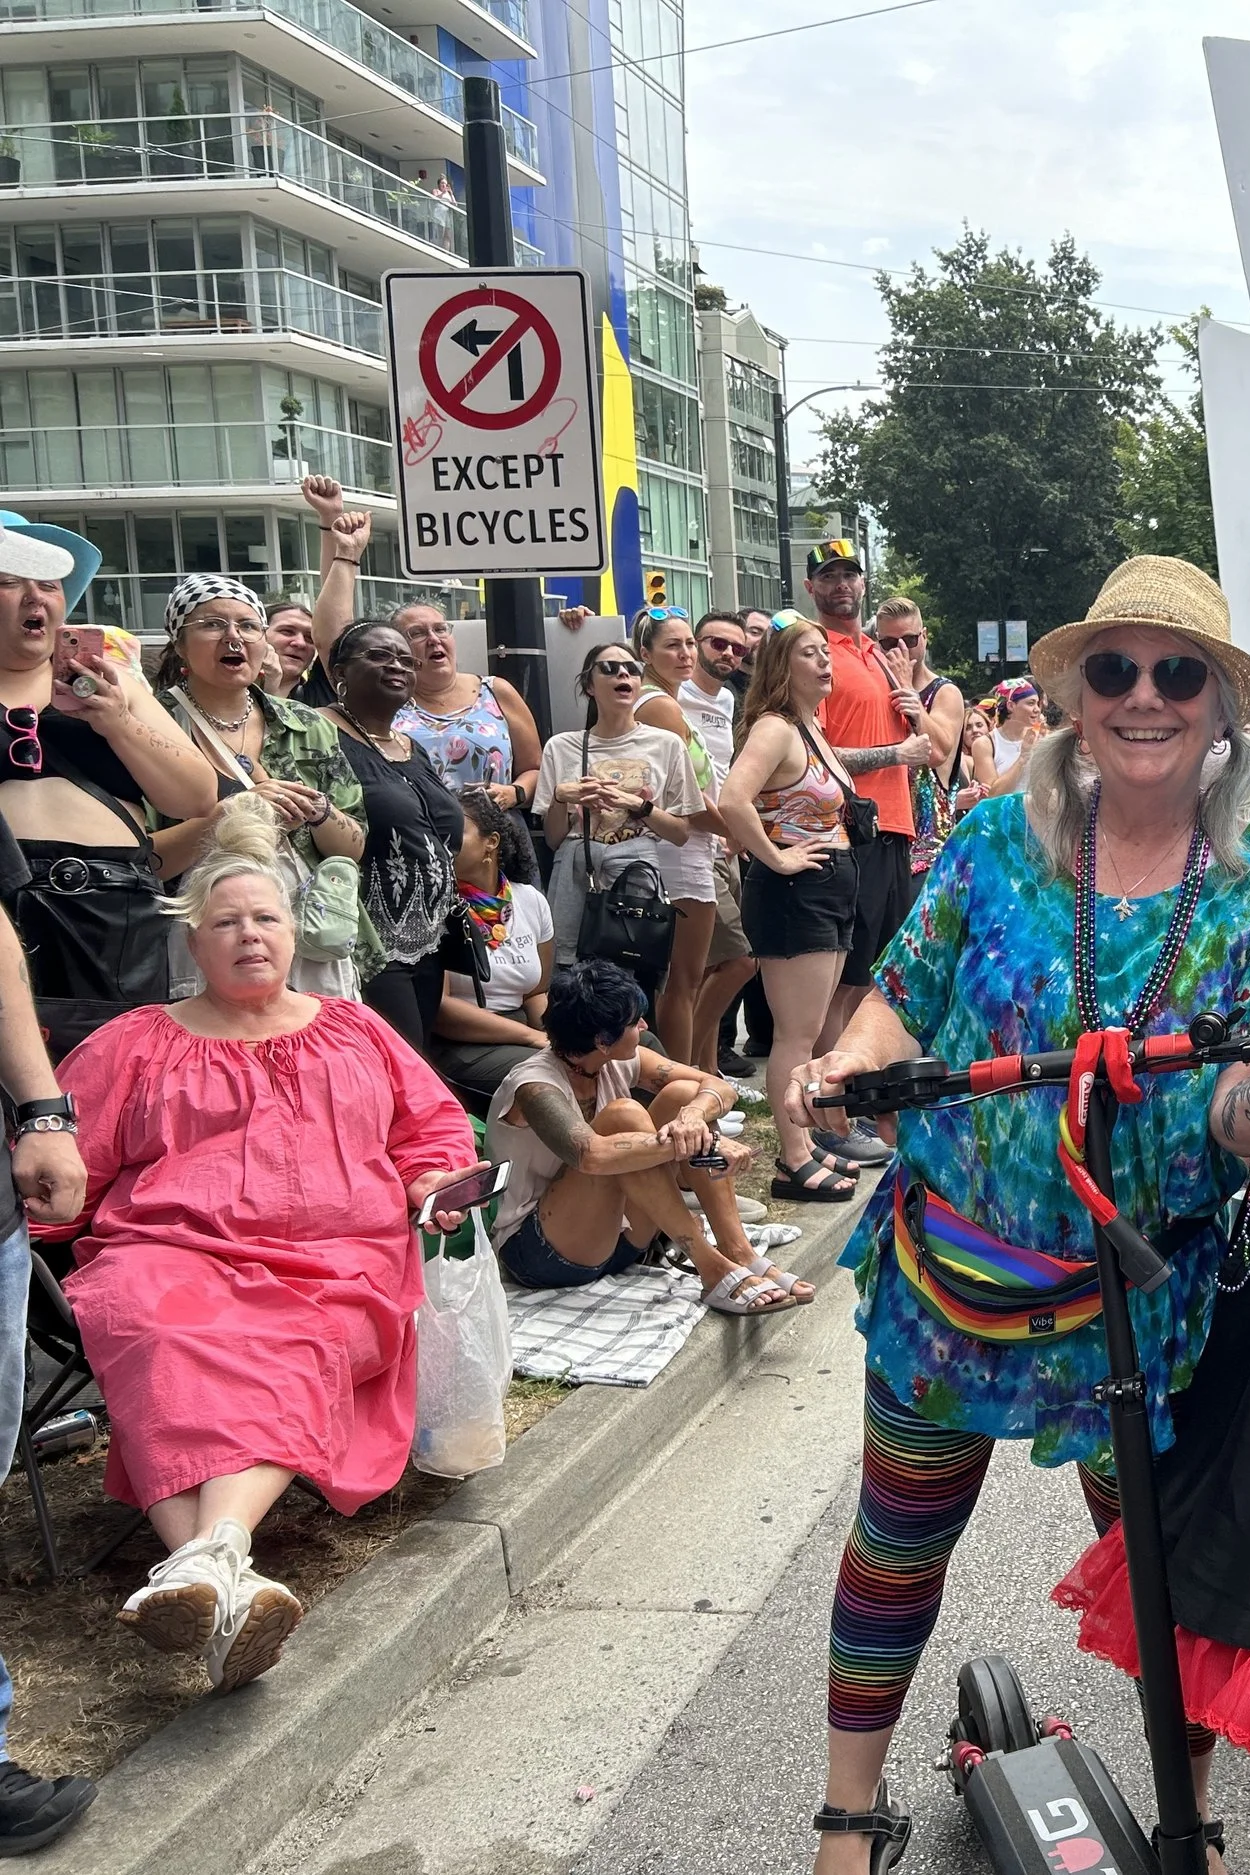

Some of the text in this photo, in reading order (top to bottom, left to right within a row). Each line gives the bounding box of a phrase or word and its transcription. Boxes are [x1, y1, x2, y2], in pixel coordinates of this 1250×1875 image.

[432, 453, 564, 491] EXCEPT
[416, 507, 590, 547] BICYCLES
[515, 933, 534, 949] gay
[1031, 1316, 1054, 1327] Vibe
